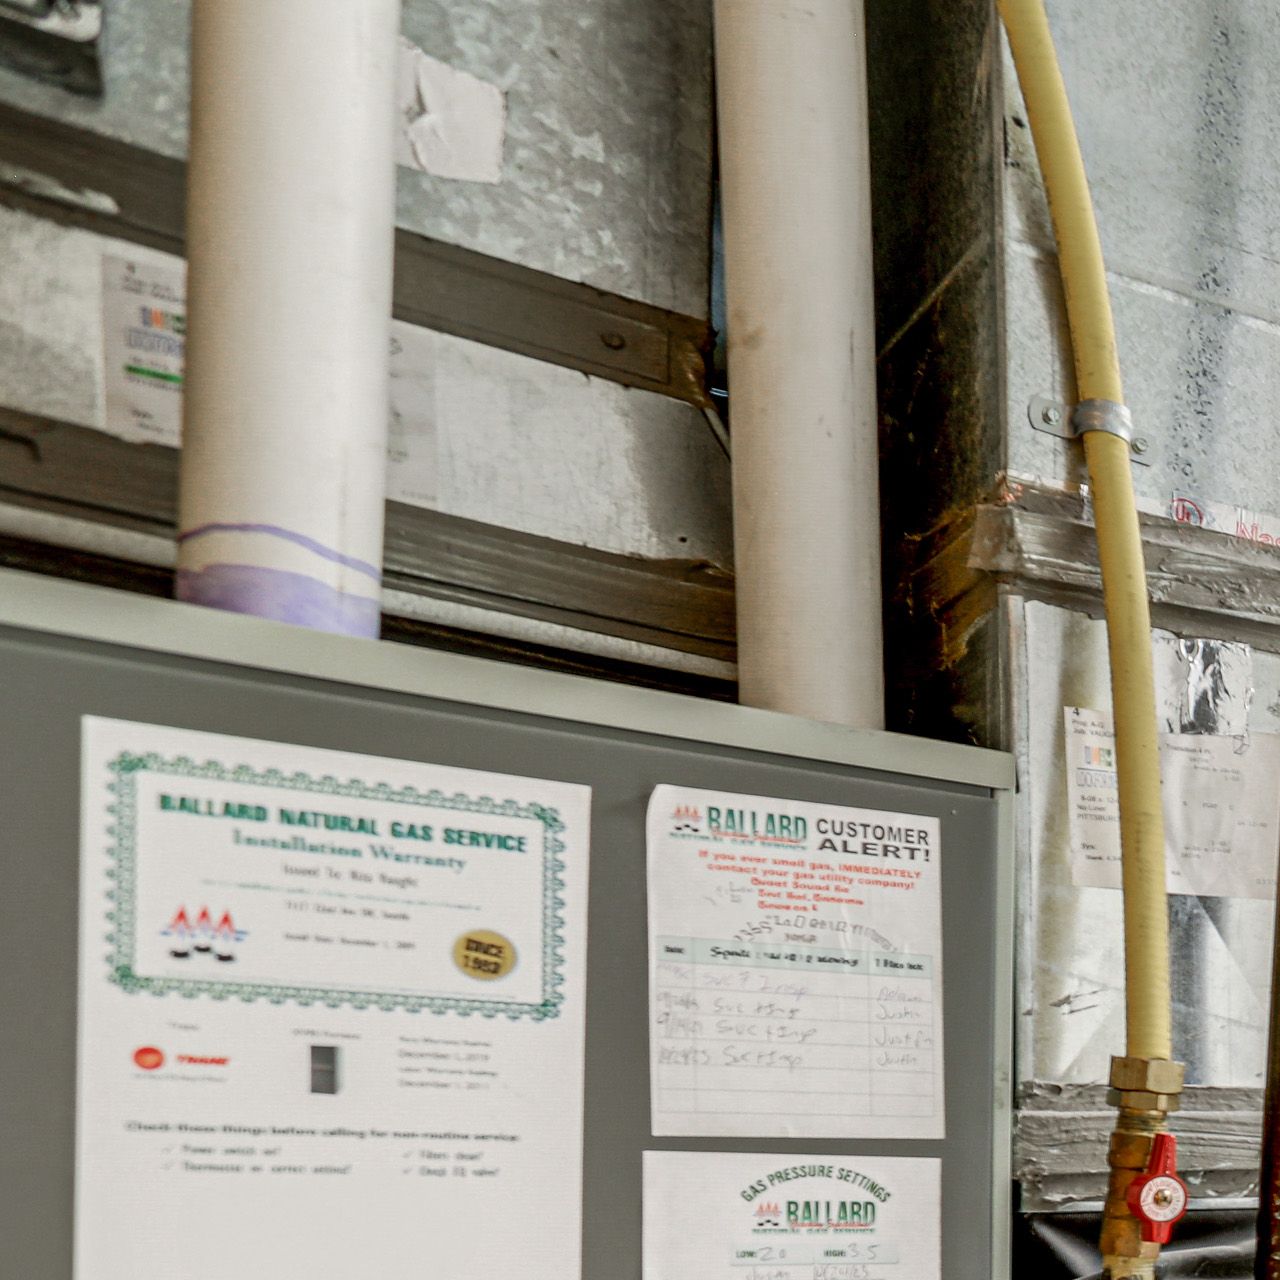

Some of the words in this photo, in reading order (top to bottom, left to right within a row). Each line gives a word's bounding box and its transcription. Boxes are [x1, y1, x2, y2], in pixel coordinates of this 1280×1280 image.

[160, 793, 268, 824] BALLARD
[279, 805, 378, 836] NATURAL
[390, 821, 433, 842] GAS
[443, 827, 527, 853] SERVICE
[706, 806, 807, 839] BALLARD
[817, 818, 929, 846] CUSTOMER
[233, 829, 363, 859] Installation
[369, 843, 467, 874] Warranty
[714, 852, 736, 863] you
[838, 863, 921, 880] IMMEDIATELY
[818, 839, 930, 863] ALERT!
[707, 864, 757, 875] contact
[762, 868, 788, 879] your
[793, 871, 814, 881] gas
[818, 873, 853, 886] utility
[740, 1179, 767, 1203] GAS
[767, 1164, 833, 1186] PRESSURE
[836, 1167, 892, 1203] SETTINGS
[786, 1200, 876, 1224] BALLARD
